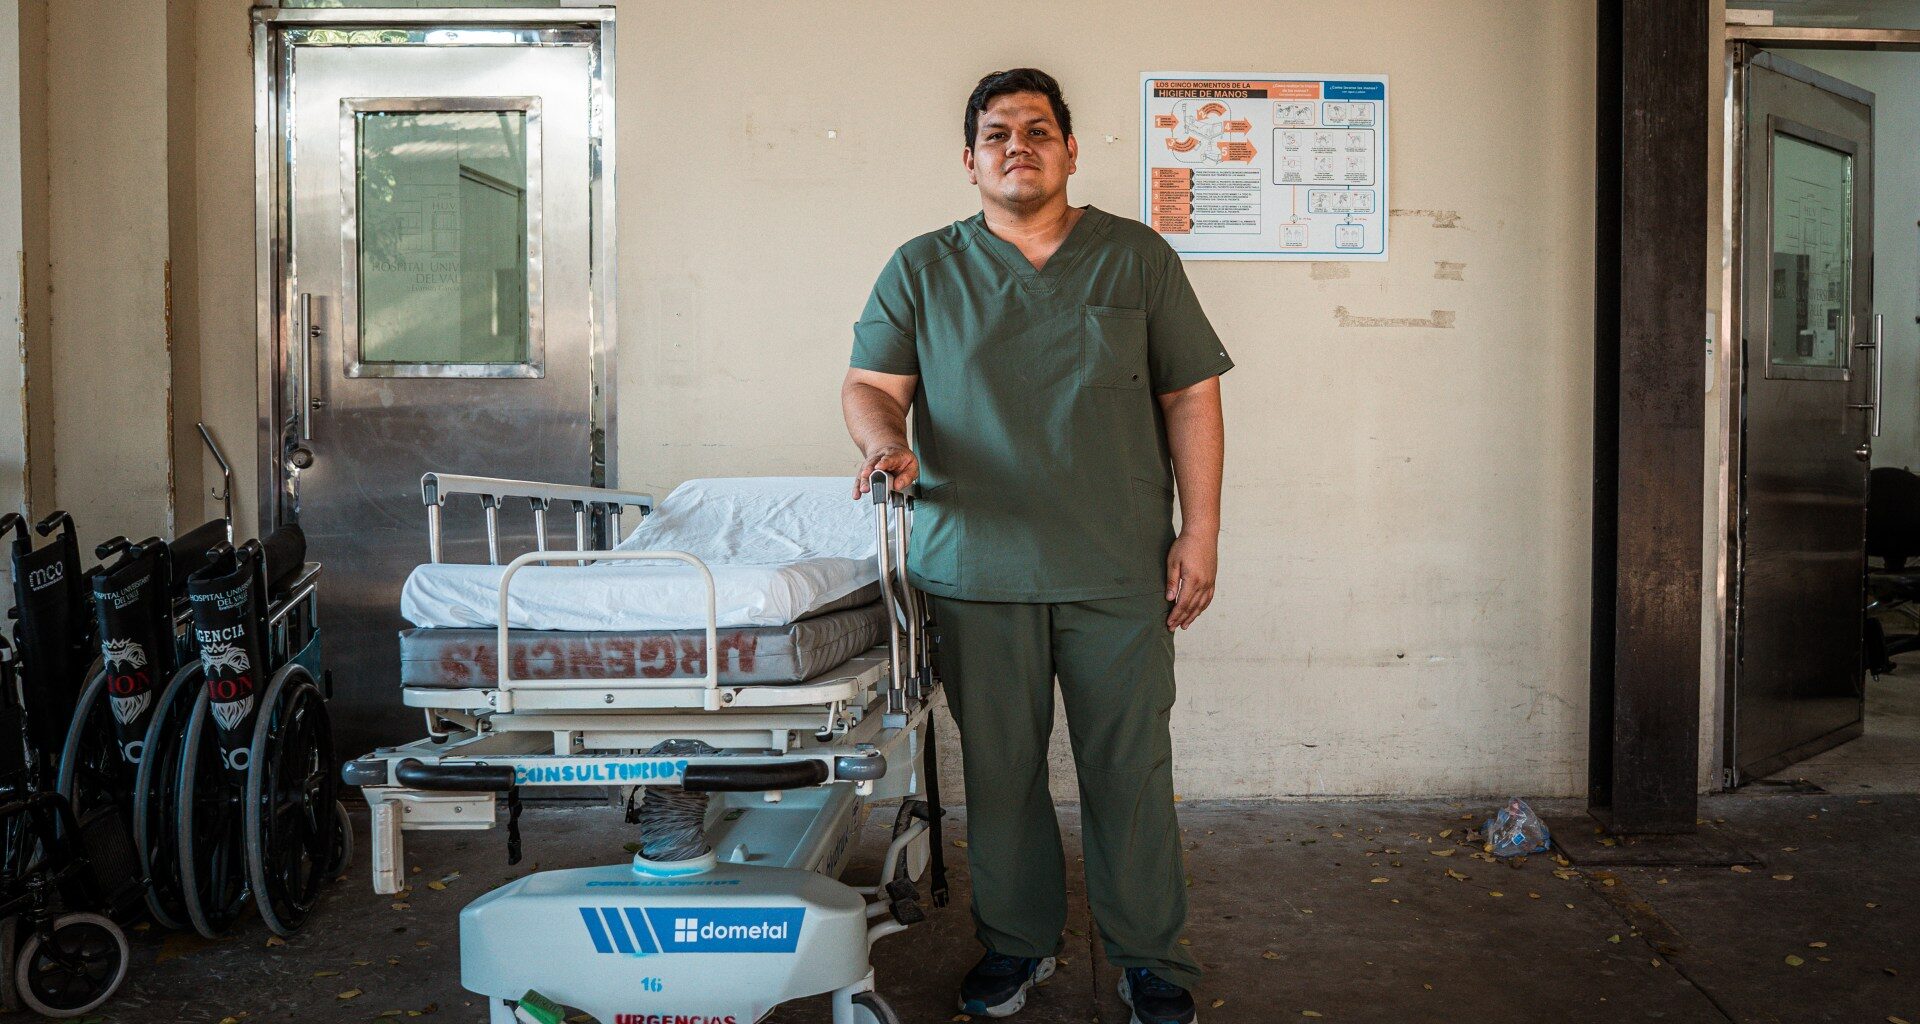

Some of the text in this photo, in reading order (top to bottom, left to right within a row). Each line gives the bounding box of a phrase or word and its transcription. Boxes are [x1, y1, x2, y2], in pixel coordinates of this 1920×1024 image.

[1159, 90, 1248, 98] HIGIENE DE MANOS
[1156, 118, 1161, 126] 1
[1222, 147, 1228, 156] 5
[217, 598, 233, 607] DEL
[700, 921, 788, 940] dometal
[641, 976, 663, 993] 16
[615, 1013, 737, 1024] URGENCIAS
